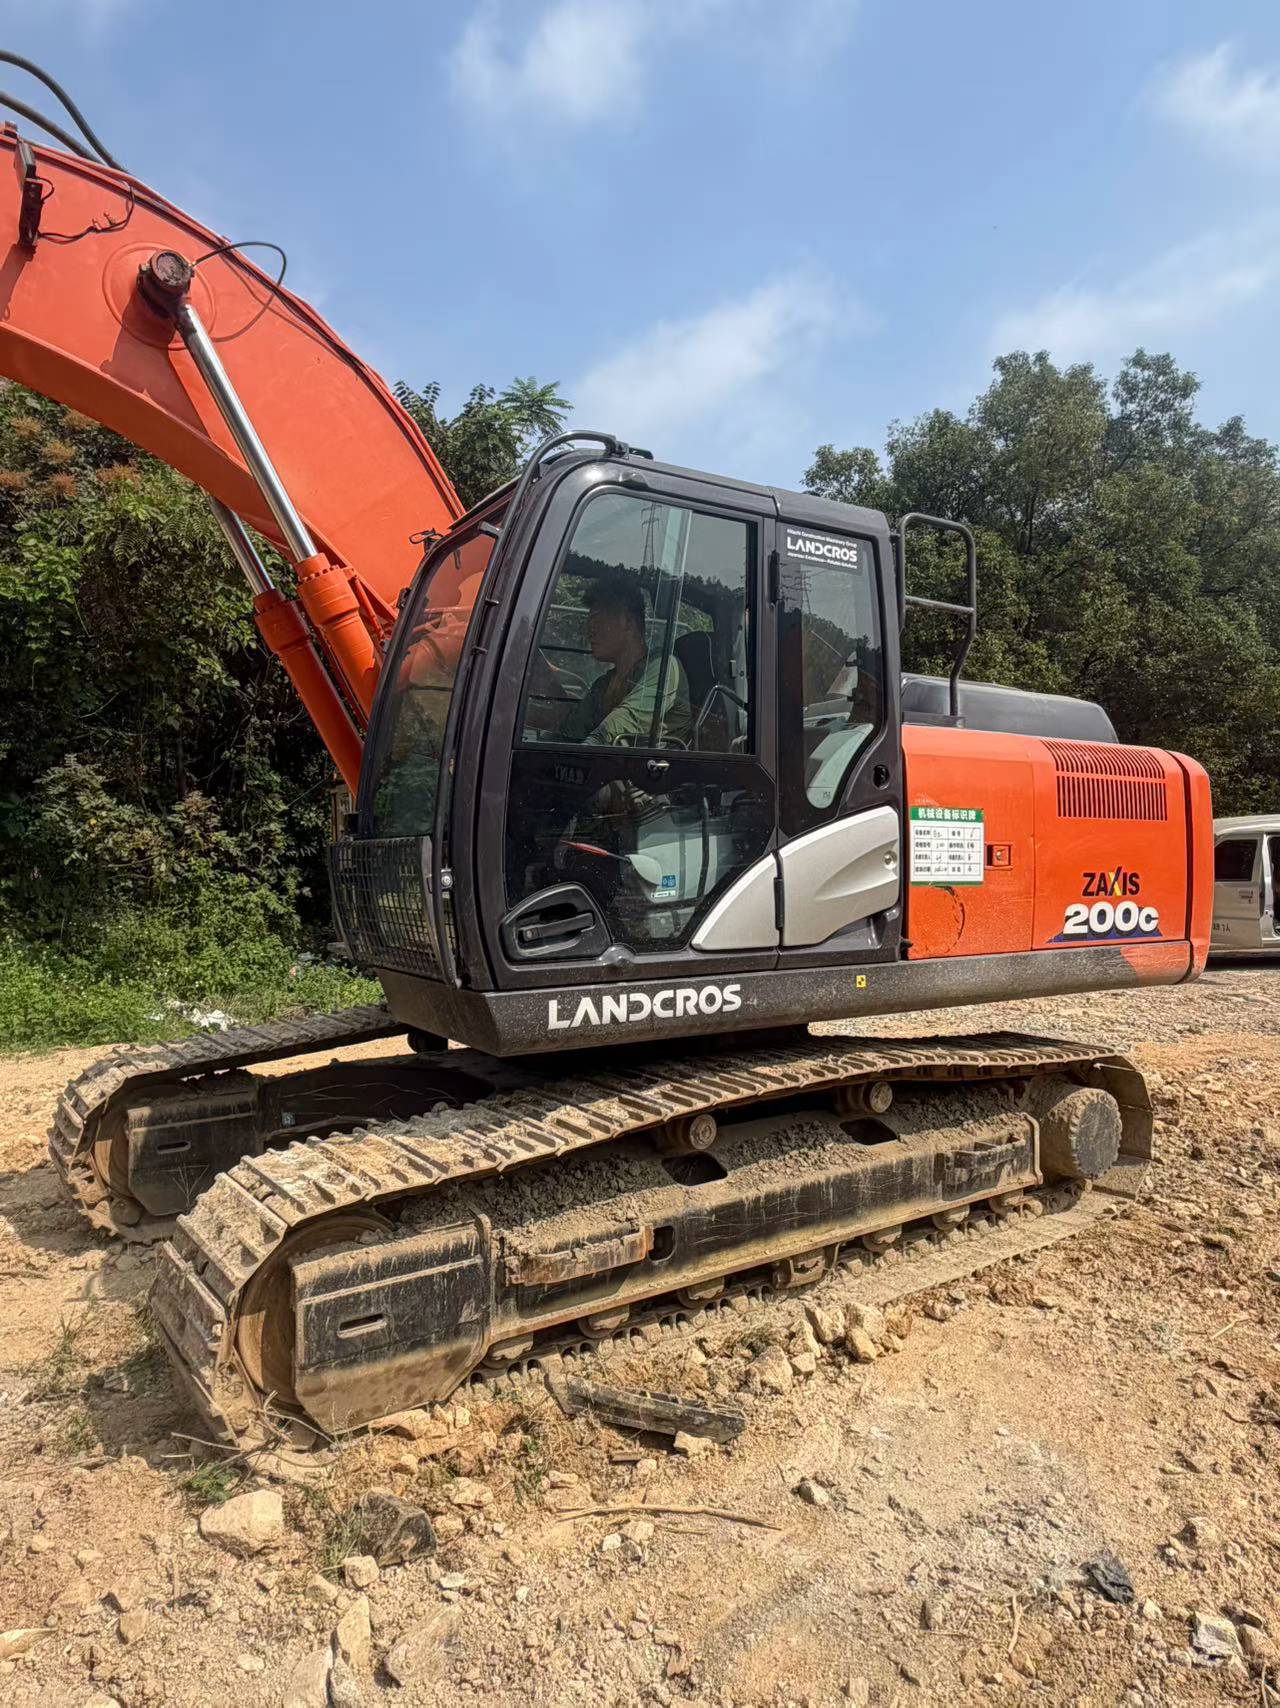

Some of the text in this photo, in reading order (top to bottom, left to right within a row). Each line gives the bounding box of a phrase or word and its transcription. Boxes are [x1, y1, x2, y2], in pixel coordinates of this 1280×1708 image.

[787, 536, 857, 562] LANDCROS
[918, 807, 976, 820] 机械设备标识牌
[1082, 866, 1140, 897] ZAXIS
[548, 984, 742, 1030] LANDCROS
